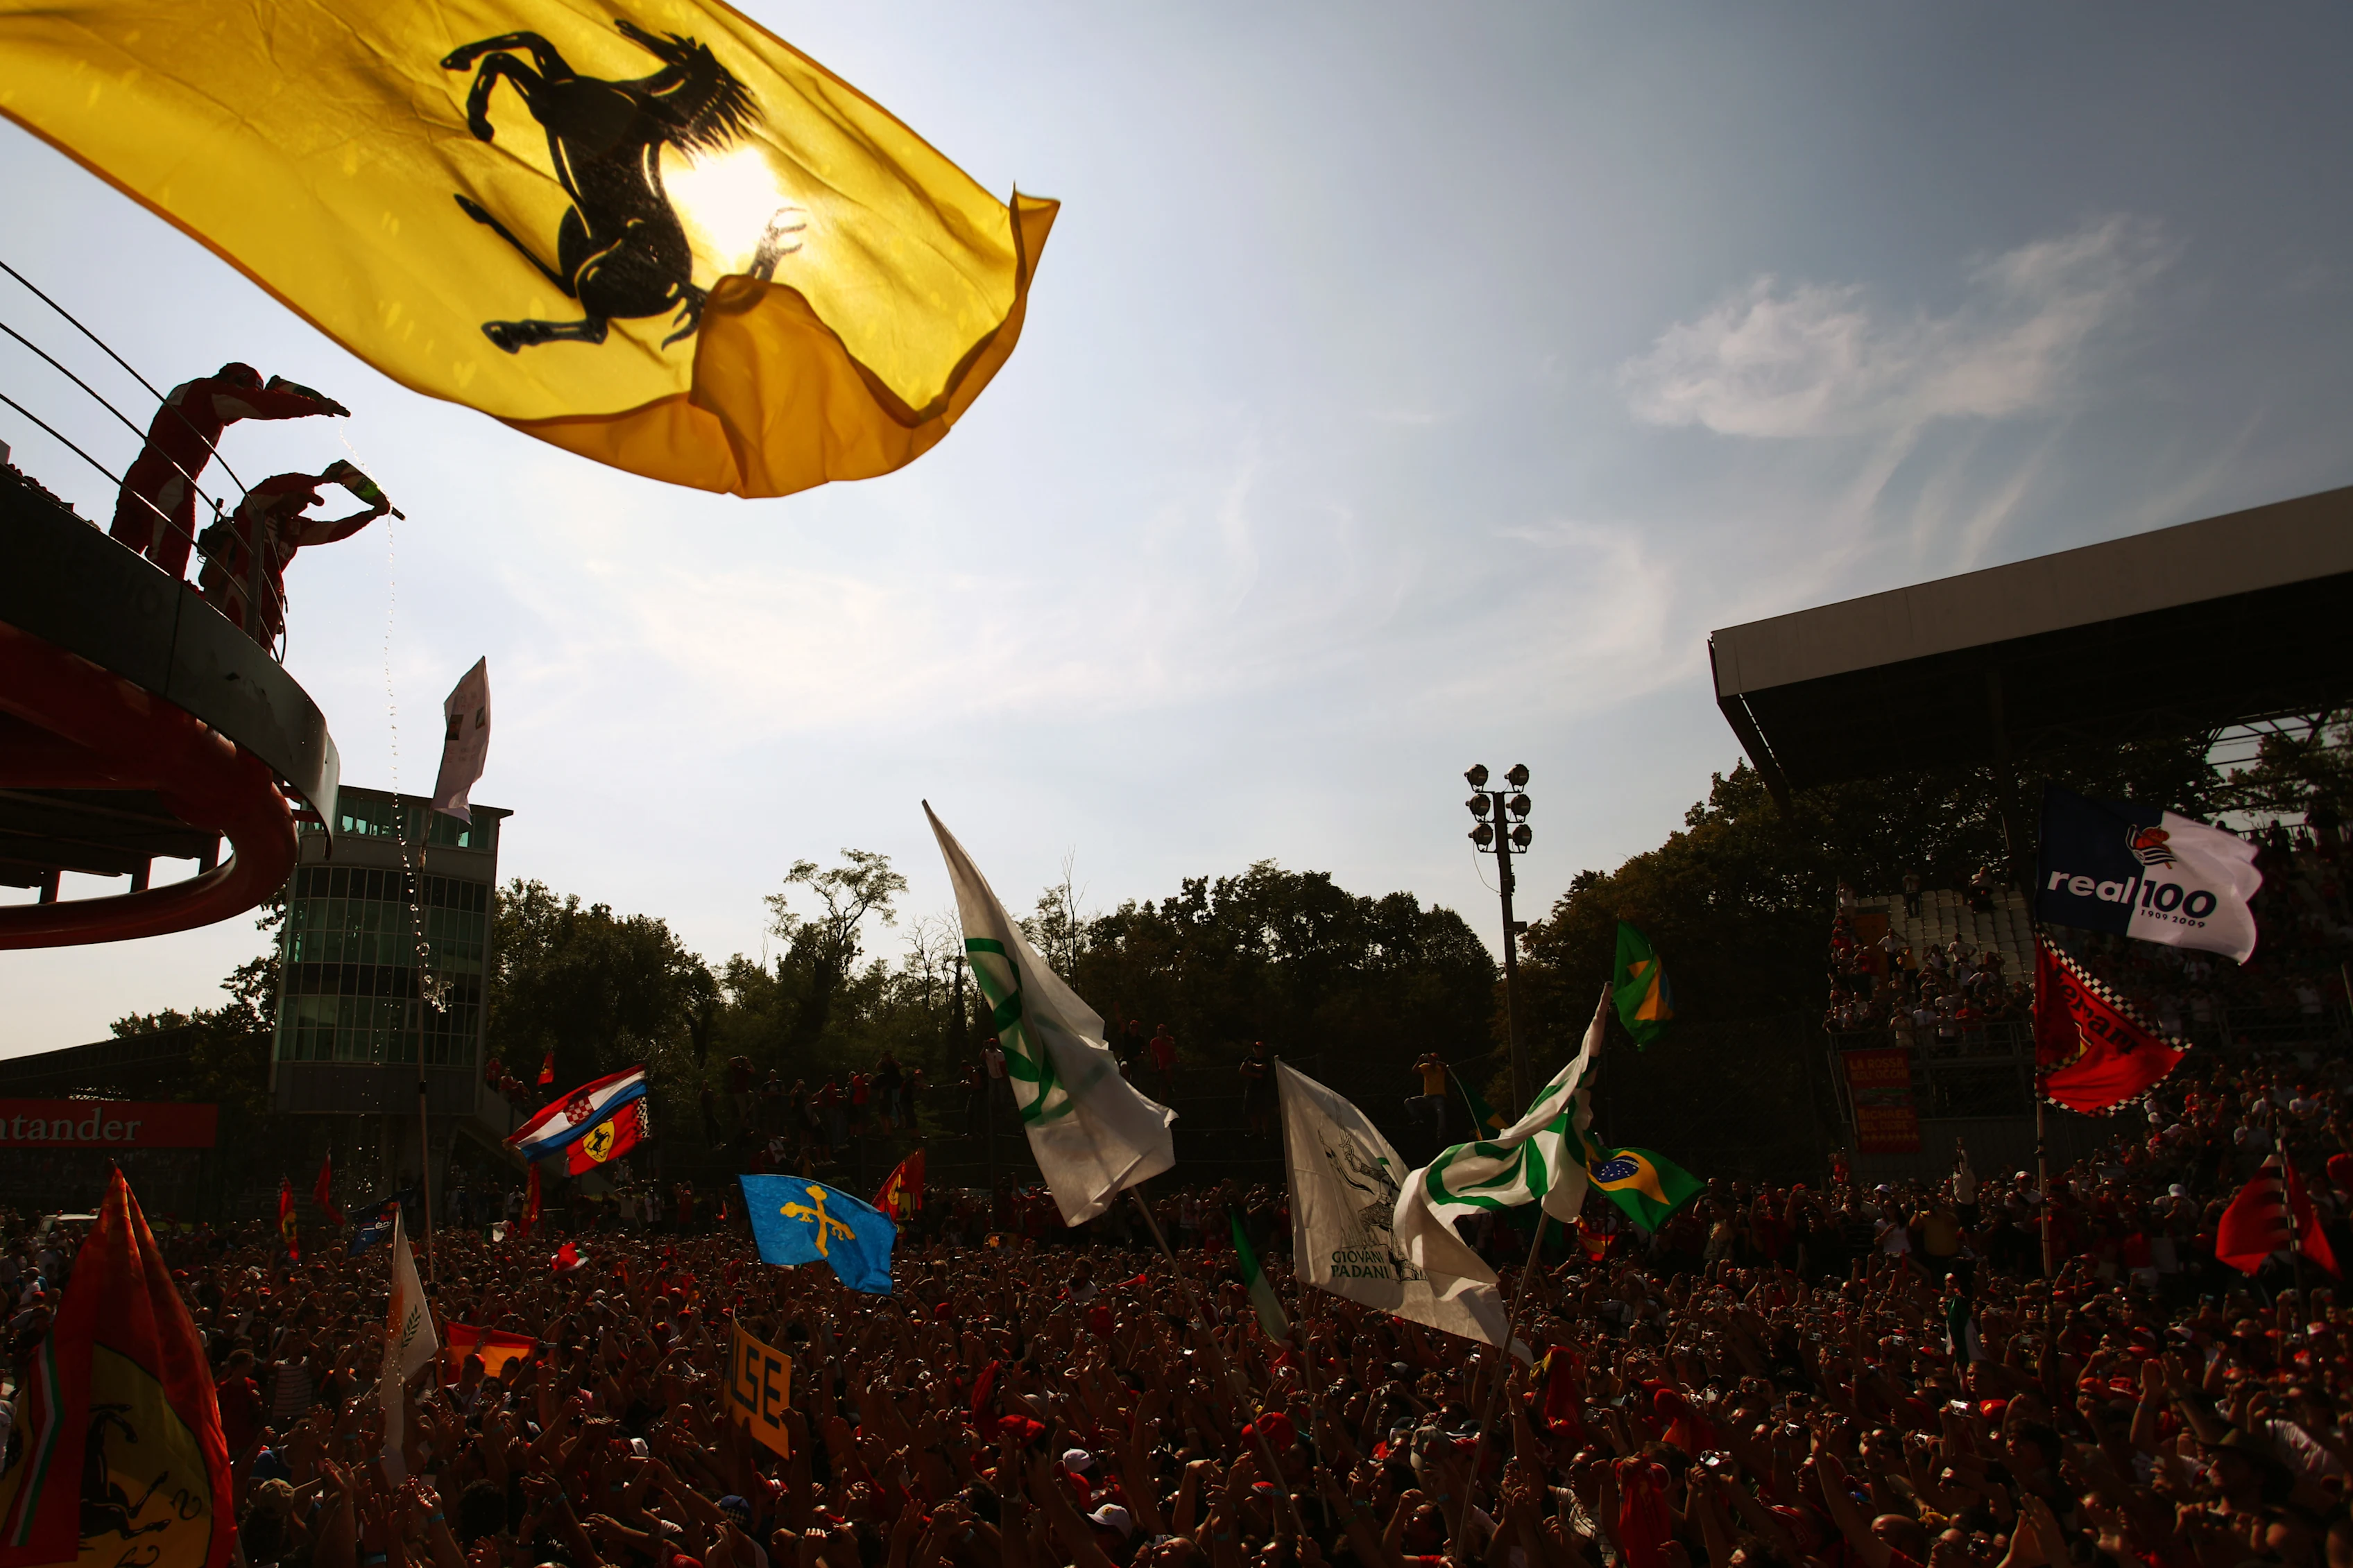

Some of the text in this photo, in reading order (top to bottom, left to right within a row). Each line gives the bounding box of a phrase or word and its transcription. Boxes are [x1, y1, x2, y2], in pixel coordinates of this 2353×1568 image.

[2047, 870, 2216, 919] real 100
[2140, 909, 2205, 929] 1909 2009
[1849, 1057, 1905, 1070] LA ROSSA
[1875, 1068, 1908, 1079] OCCHI
[1857, 1109, 1915, 1121] MICHAEL
[1331, 1250, 1385, 1263] GIOVANI
[1330, 1265, 1390, 1279] PADANI
